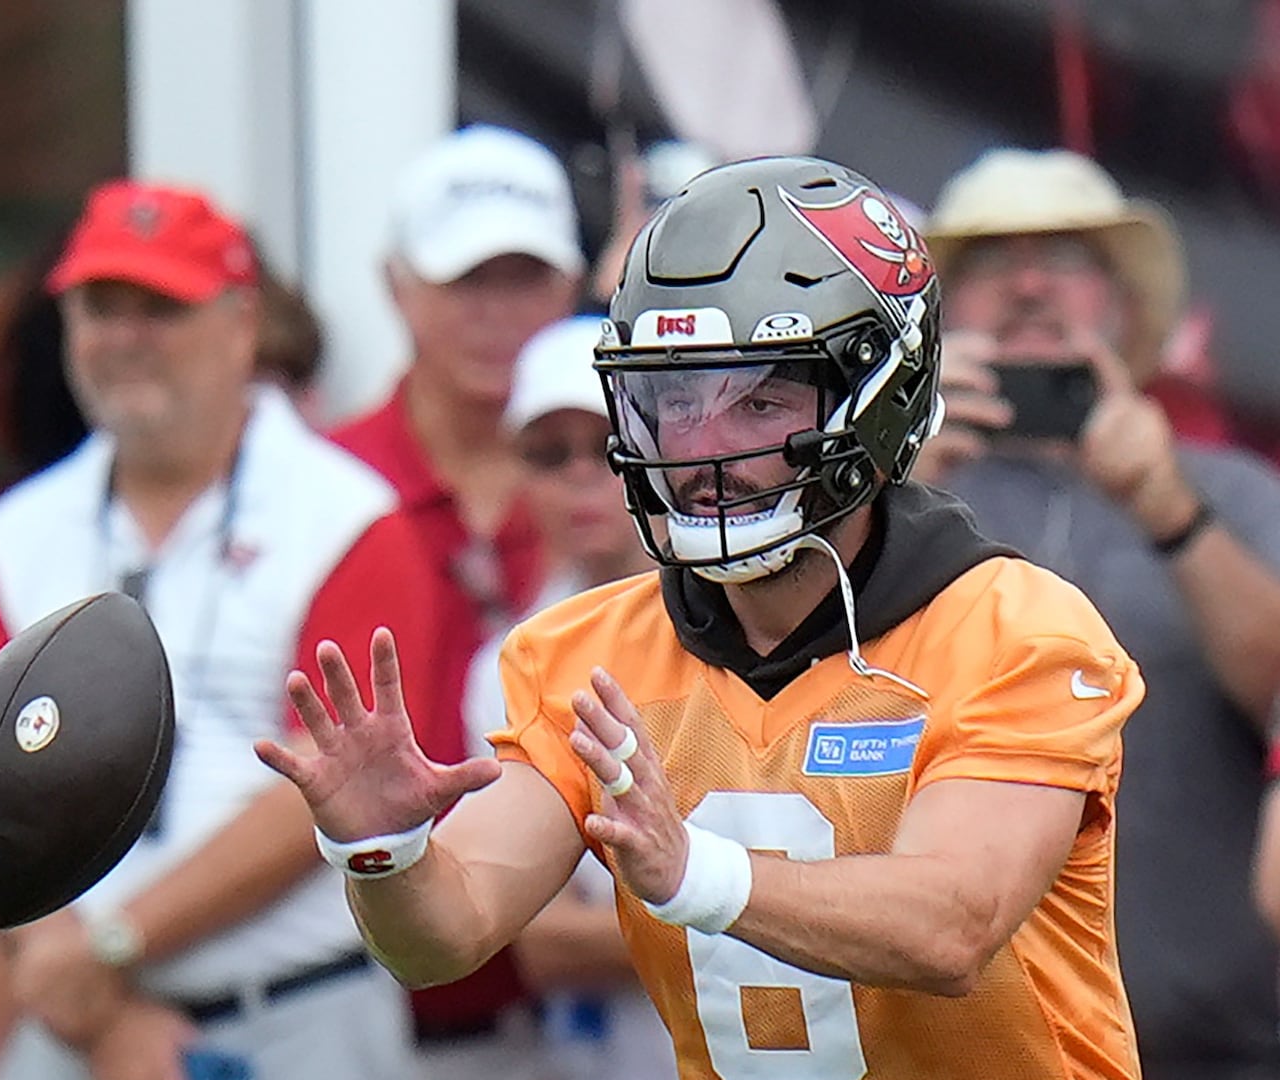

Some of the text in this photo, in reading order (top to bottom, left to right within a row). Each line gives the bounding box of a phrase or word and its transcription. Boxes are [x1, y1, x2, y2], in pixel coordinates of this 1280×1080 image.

[656, 314, 696, 338] BUCS
[756, 328, 808, 340] OAKLEY
[851, 739, 888, 751] FIFTH
[849, 750, 885, 761] BANK
